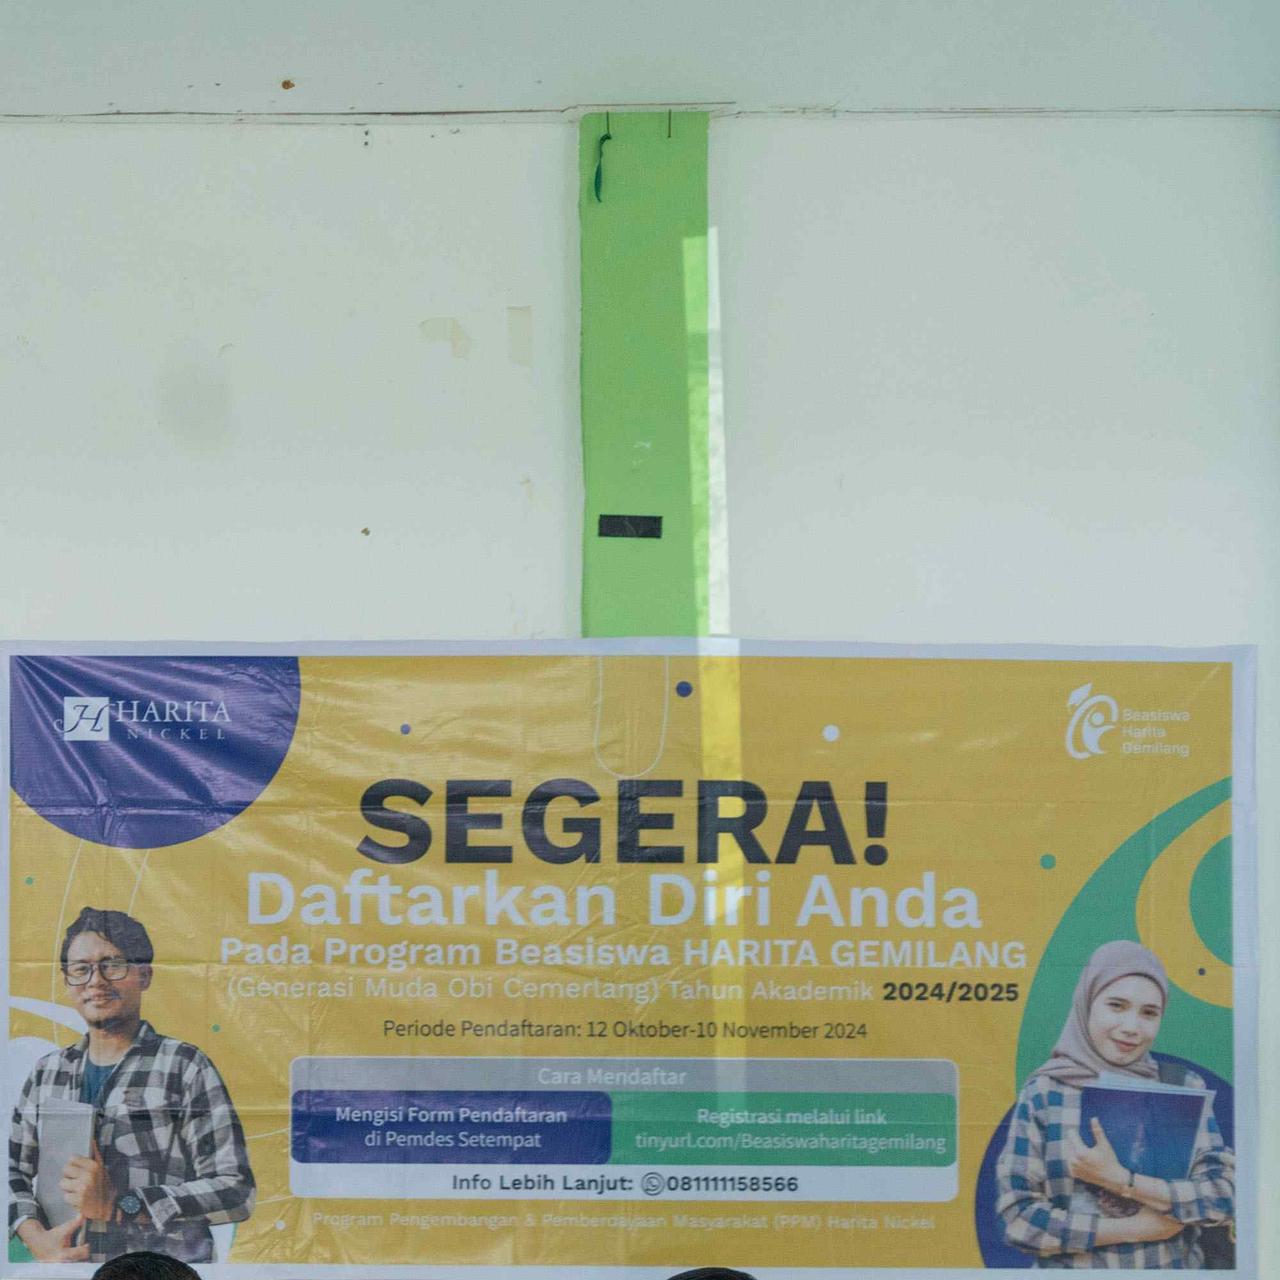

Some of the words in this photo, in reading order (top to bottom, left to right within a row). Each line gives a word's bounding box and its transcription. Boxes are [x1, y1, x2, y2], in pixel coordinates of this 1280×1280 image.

[115, 700, 231, 723] HARITA
[128, 727, 227, 741] NICKEL
[356, 778, 889, 867] SEGERA!
[247, 868, 616, 926] Daftarkan
[648, 869, 771, 927] Diri
[796, 870, 982, 929] Anda
[220, 936, 312, 966] Pada
[324, 937, 480, 972] Program
[495, 936, 669, 967] Beasiswa
[684, 939, 819, 967] HARITA
[831, 940, 1027, 968] GEMILANG
[227, 976, 354, 1002] (Generasi
[365, 977, 438, 998] Muda
[448, 976, 493, 998] Obi
[504, 977, 660, 1003] Cemerlang)
[669, 979, 743, 1000] Tahun
[751, 980, 874, 1001] Akademik
[883, 980, 1019, 1003] 2024/2025
[383, 1019, 455, 1037] Periode
[461, 1019, 582, 1037] Pendaftaran:
[587, 1021, 608, 1037] 12
[613, 1021, 717, 1039] Oktober-10
[723, 1022, 818, 1039] November
[824, 1022, 868, 1039] 2024
[538, 1068, 582, 1086] Cara
[587, 1068, 687, 1086] Mendaftar
[335, 1106, 404, 1125] Mengisi
[408, 1107, 454, 1122] Form
[459, 1107, 568, 1124] Pendaftaran
[697, 1109, 782, 1127] Registrasi
[786, 1109, 851, 1125] melalui
[855, 1108, 888, 1125] link
[364, 1131, 381, 1147] di
[386, 1131, 454, 1147] Pemdes
[458, 1131, 542, 1151] Setempat
[452, 1174, 491, 1191] Info
[499, 1174, 555, 1191] Lebih
[562, 1174, 633, 1194] Lanjut:
[667, 1174, 798, 1192] 081111158566
